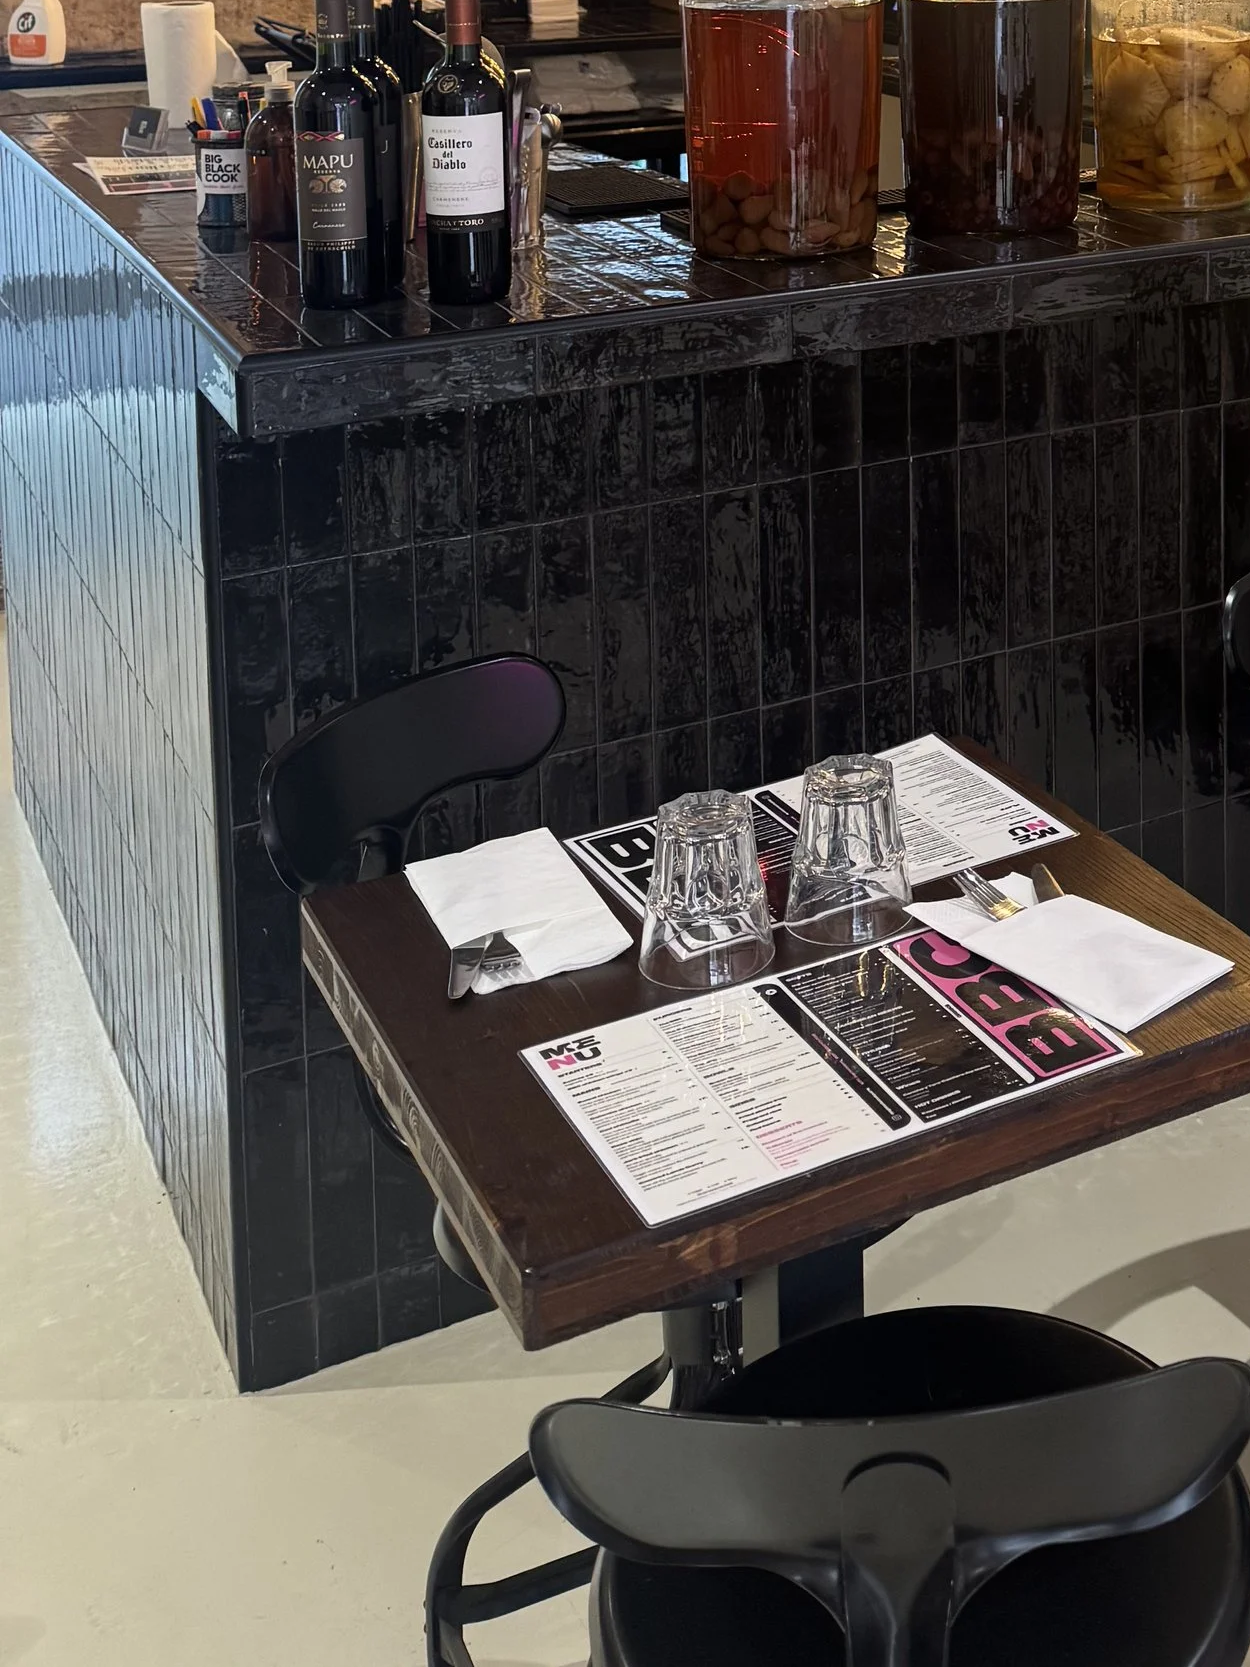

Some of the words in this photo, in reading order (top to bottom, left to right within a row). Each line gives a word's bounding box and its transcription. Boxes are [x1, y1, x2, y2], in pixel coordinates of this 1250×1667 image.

[19, 15, 33, 31] Cif
[427, 136, 473, 149] Casillero
[204, 154, 223, 164] BIG
[442, 150, 454, 159] del
[303, 154, 354, 169] MAPU
[432, 158, 467, 170] Diablo
[205, 163, 241, 174] BLACK
[205, 173, 239, 183] COOK
[459, 218, 485, 227] TORO
[538, 1034, 602, 1062] ME
[546, 1046, 602, 1072] NU
